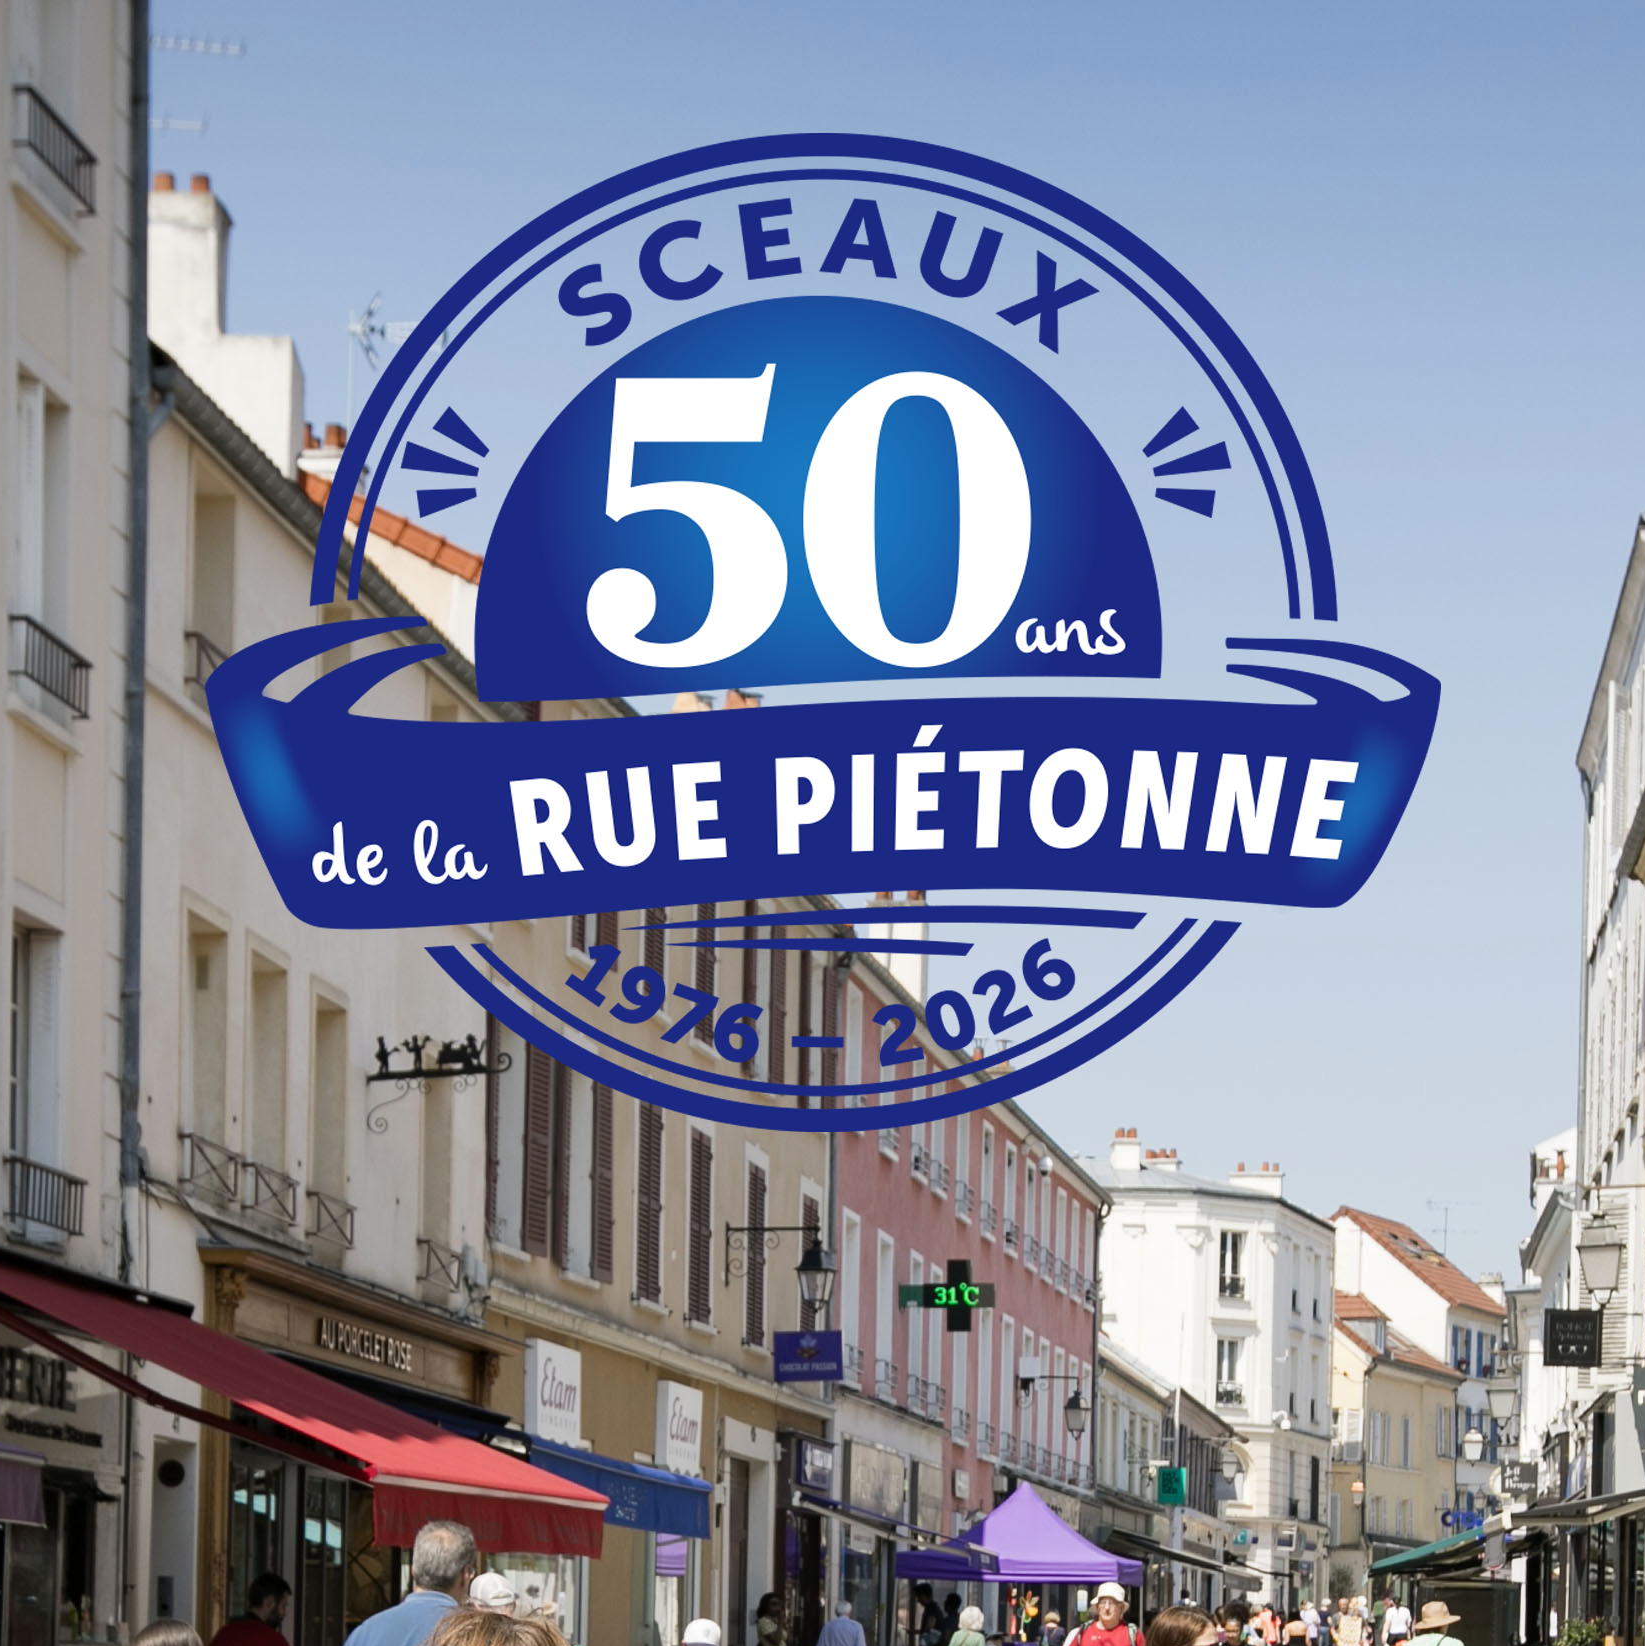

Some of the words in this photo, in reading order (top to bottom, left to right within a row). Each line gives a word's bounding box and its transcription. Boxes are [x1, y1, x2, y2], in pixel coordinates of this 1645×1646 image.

[934, 1282, 980, 1307] 31°C
[320, 1316, 336, 1350] AU
[338, 1322, 387, 1363] PORCELET
[388, 1337, 412, 1372] ROSE
[541, 1357, 577, 1413] Etam
[669, 1397, 698, 1445] Etam
